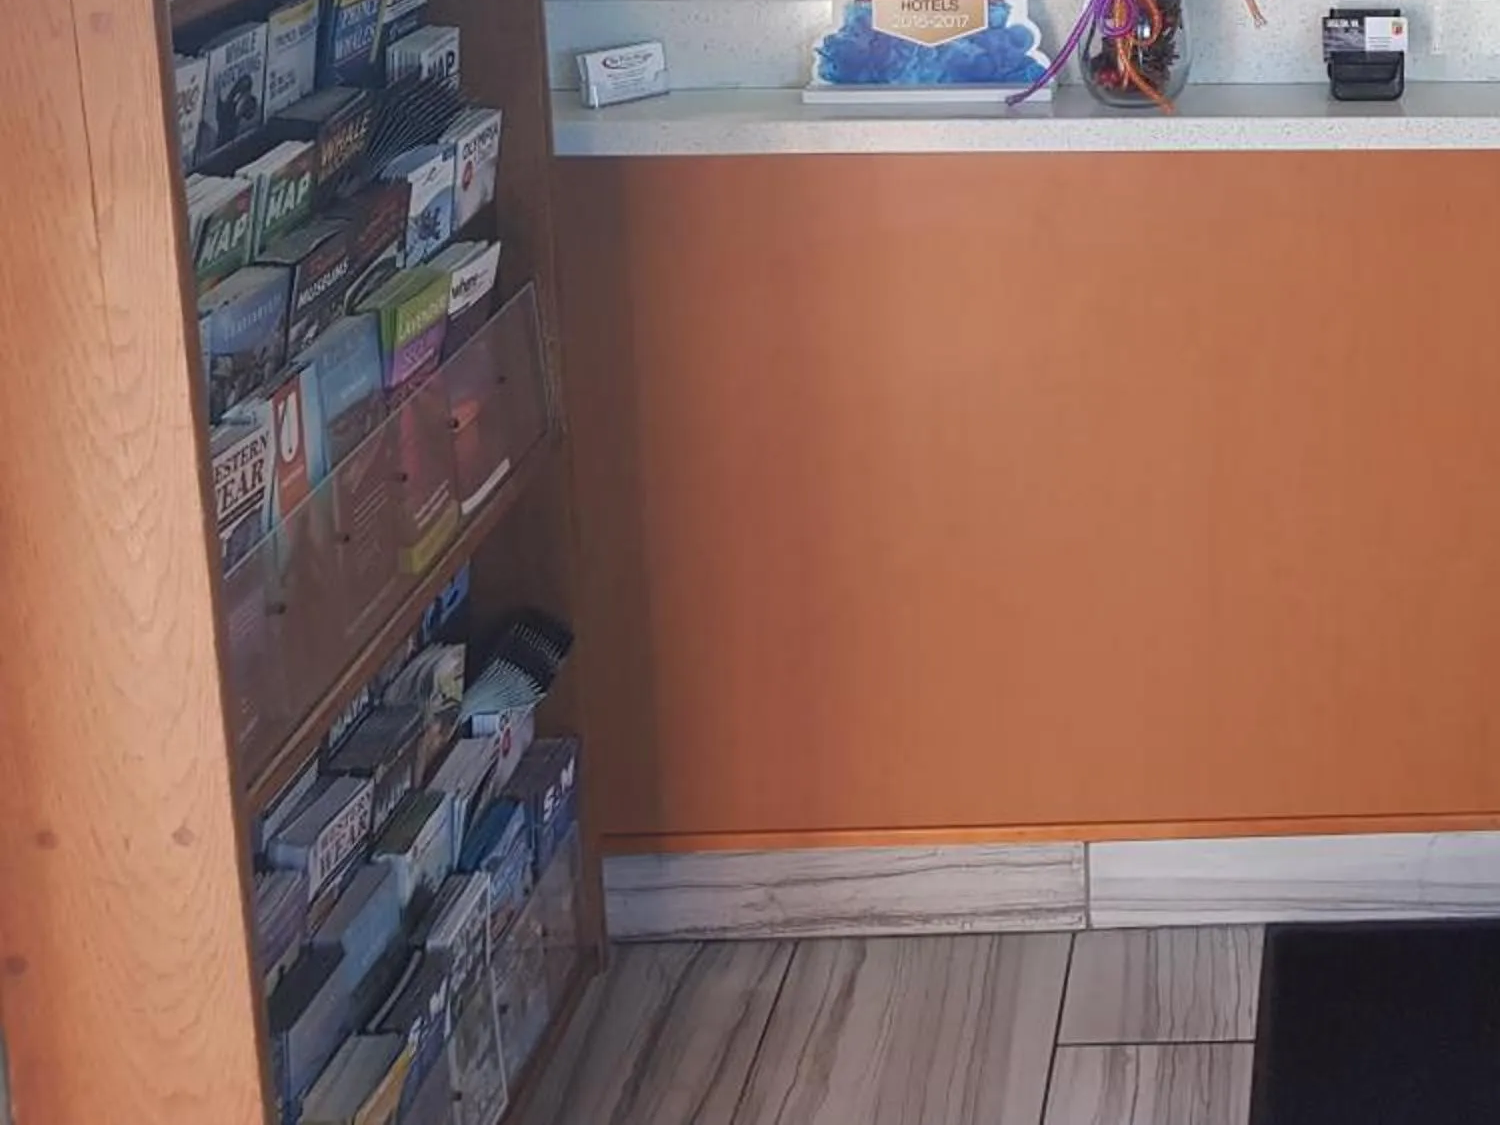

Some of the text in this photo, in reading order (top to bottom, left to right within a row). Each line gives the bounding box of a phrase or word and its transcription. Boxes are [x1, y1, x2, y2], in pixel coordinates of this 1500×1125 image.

[265, 171, 311, 228] MAP
[199, 212, 248, 268] MAP
[214, 430, 270, 485] ESTERN
